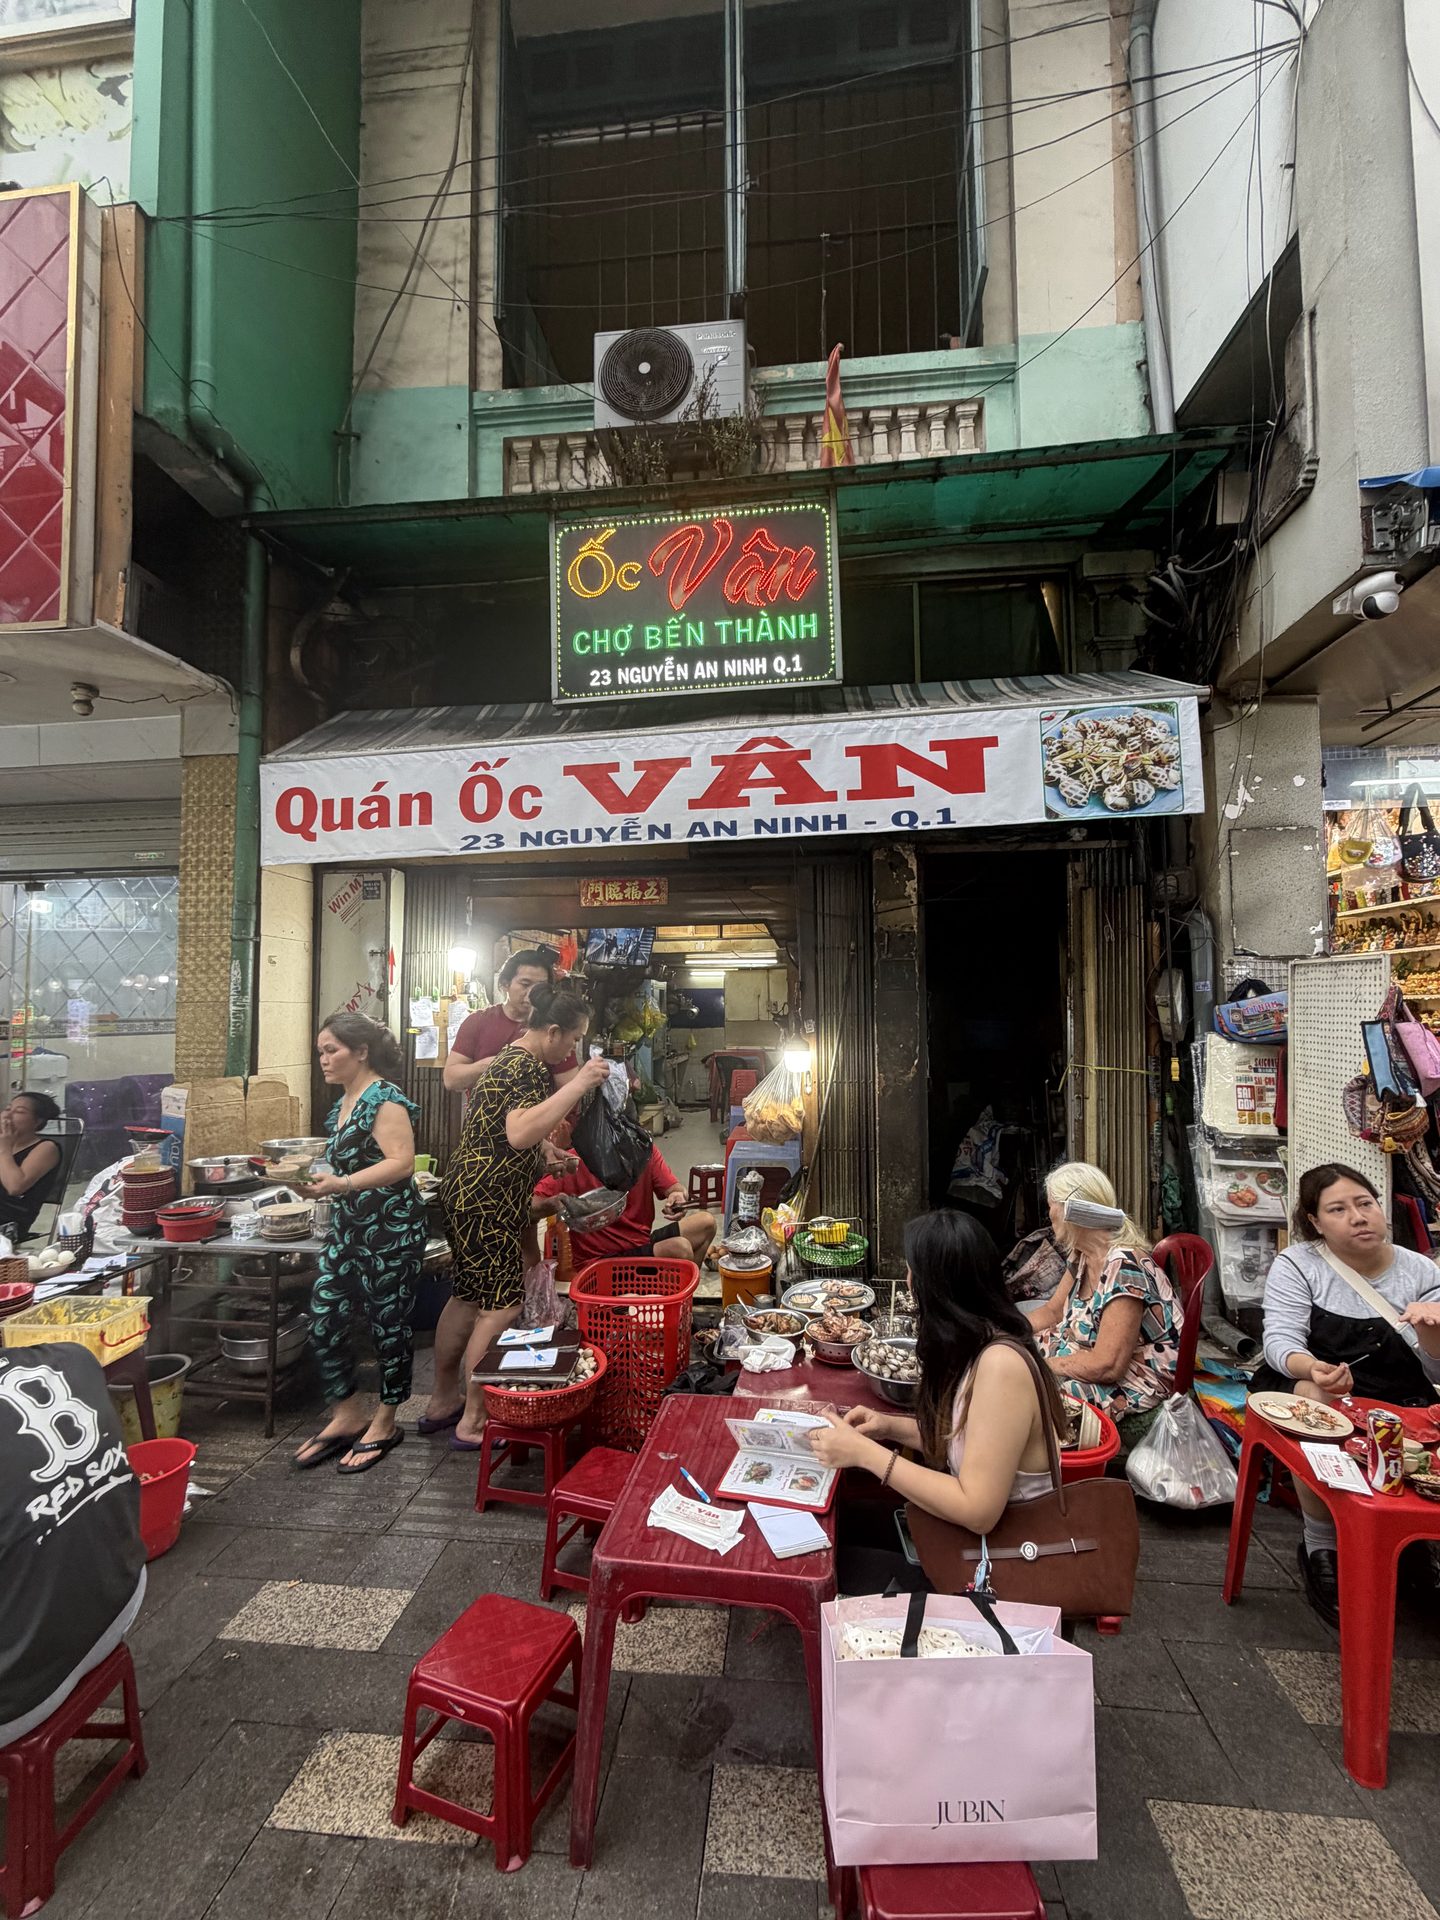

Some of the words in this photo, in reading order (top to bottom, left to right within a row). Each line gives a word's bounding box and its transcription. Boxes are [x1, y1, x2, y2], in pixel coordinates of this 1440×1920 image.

[567, 528, 643, 598] Ốc
[648, 518, 817, 611] Vân
[572, 624, 634, 656] CHỢ
[644, 613, 705, 650] BẾN
[714, 610, 818, 645] THÀNH
[589, 670, 612, 686] 23
[617, 656, 689, 684] NGUYỄN
[694, 660, 719, 679] AN
[724, 657, 767, 677] NINH
[773, 654, 803, 675] Q.1
[275, 781, 433, 842] Quán
[458, 757, 543, 823] Ốc
[562, 735, 999, 815] VÂN
[460, 833, 505, 851] 23
[519, 817, 671, 848] NGUYỄN
[686, 819, 738, 839] AN
[754, 813, 847, 835] NINH
[890, 807, 957, 829] Q.1
[0, 1364, 100, 1483] B
[25, 1476, 84, 1522] RED
[931, 1799, 1006, 1830] JUBIN
